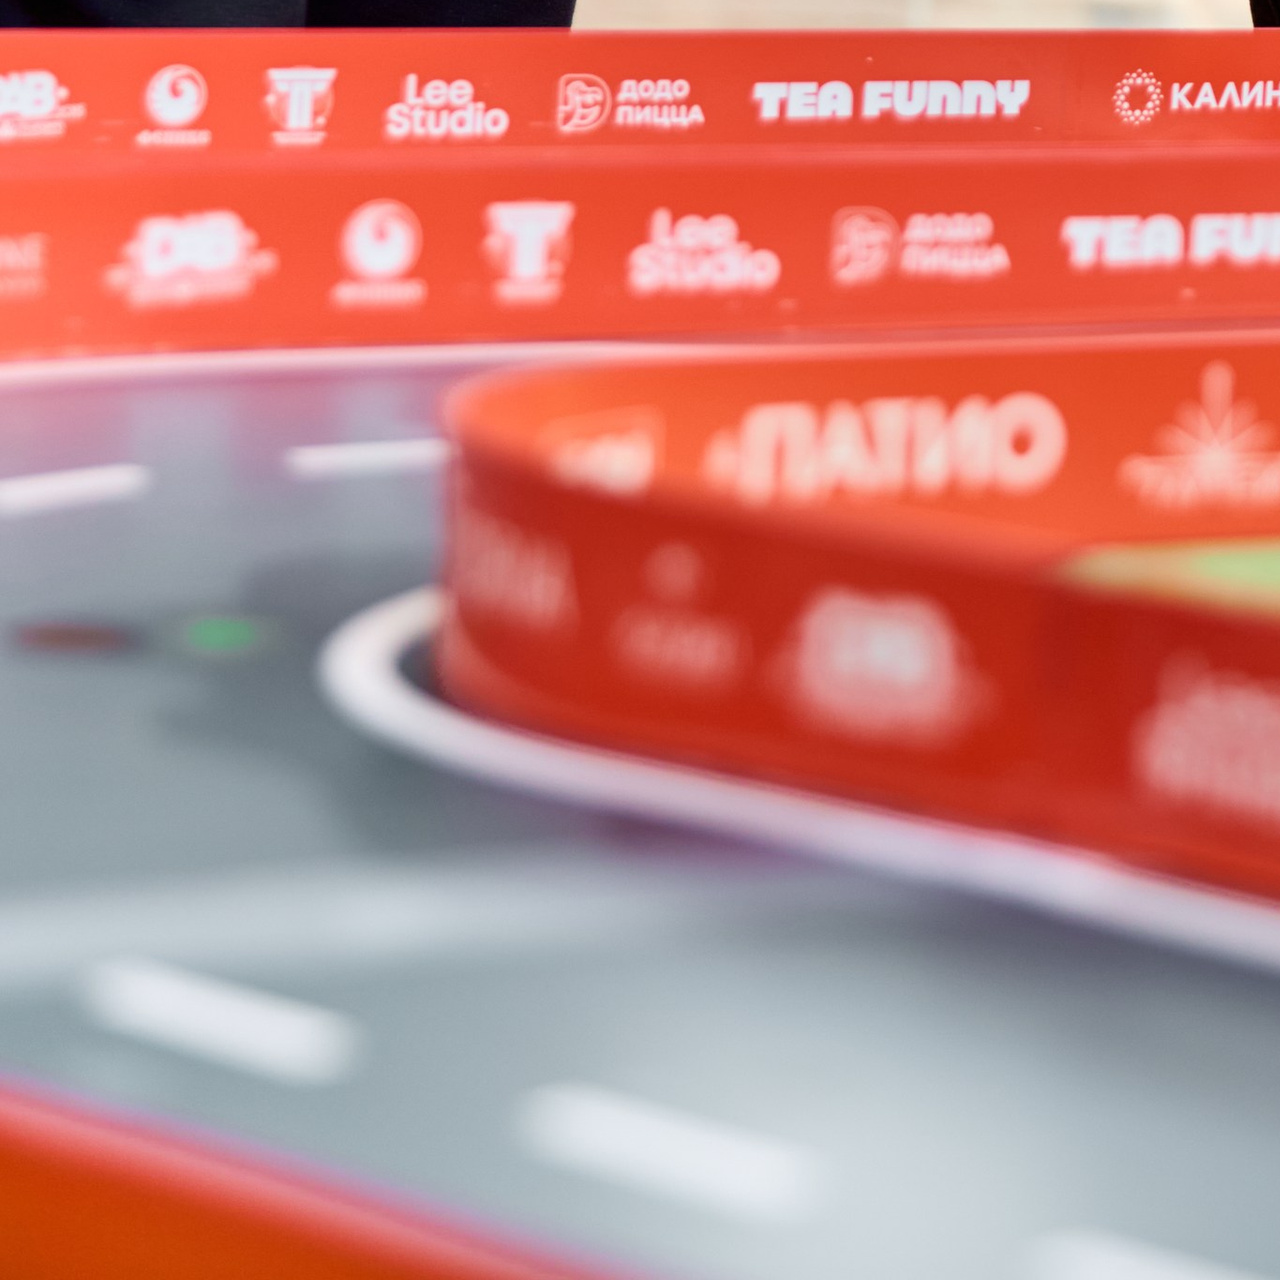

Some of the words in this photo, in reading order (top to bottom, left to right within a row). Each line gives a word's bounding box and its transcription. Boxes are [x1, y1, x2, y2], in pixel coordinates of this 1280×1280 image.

[404, 73, 474, 106] Lee
[752, 81, 853, 122] TEA
[861, 80, 1030, 120] FUNNY
[386, 100, 509, 139] Studio
[1061, 214, 1186, 269] TEA
